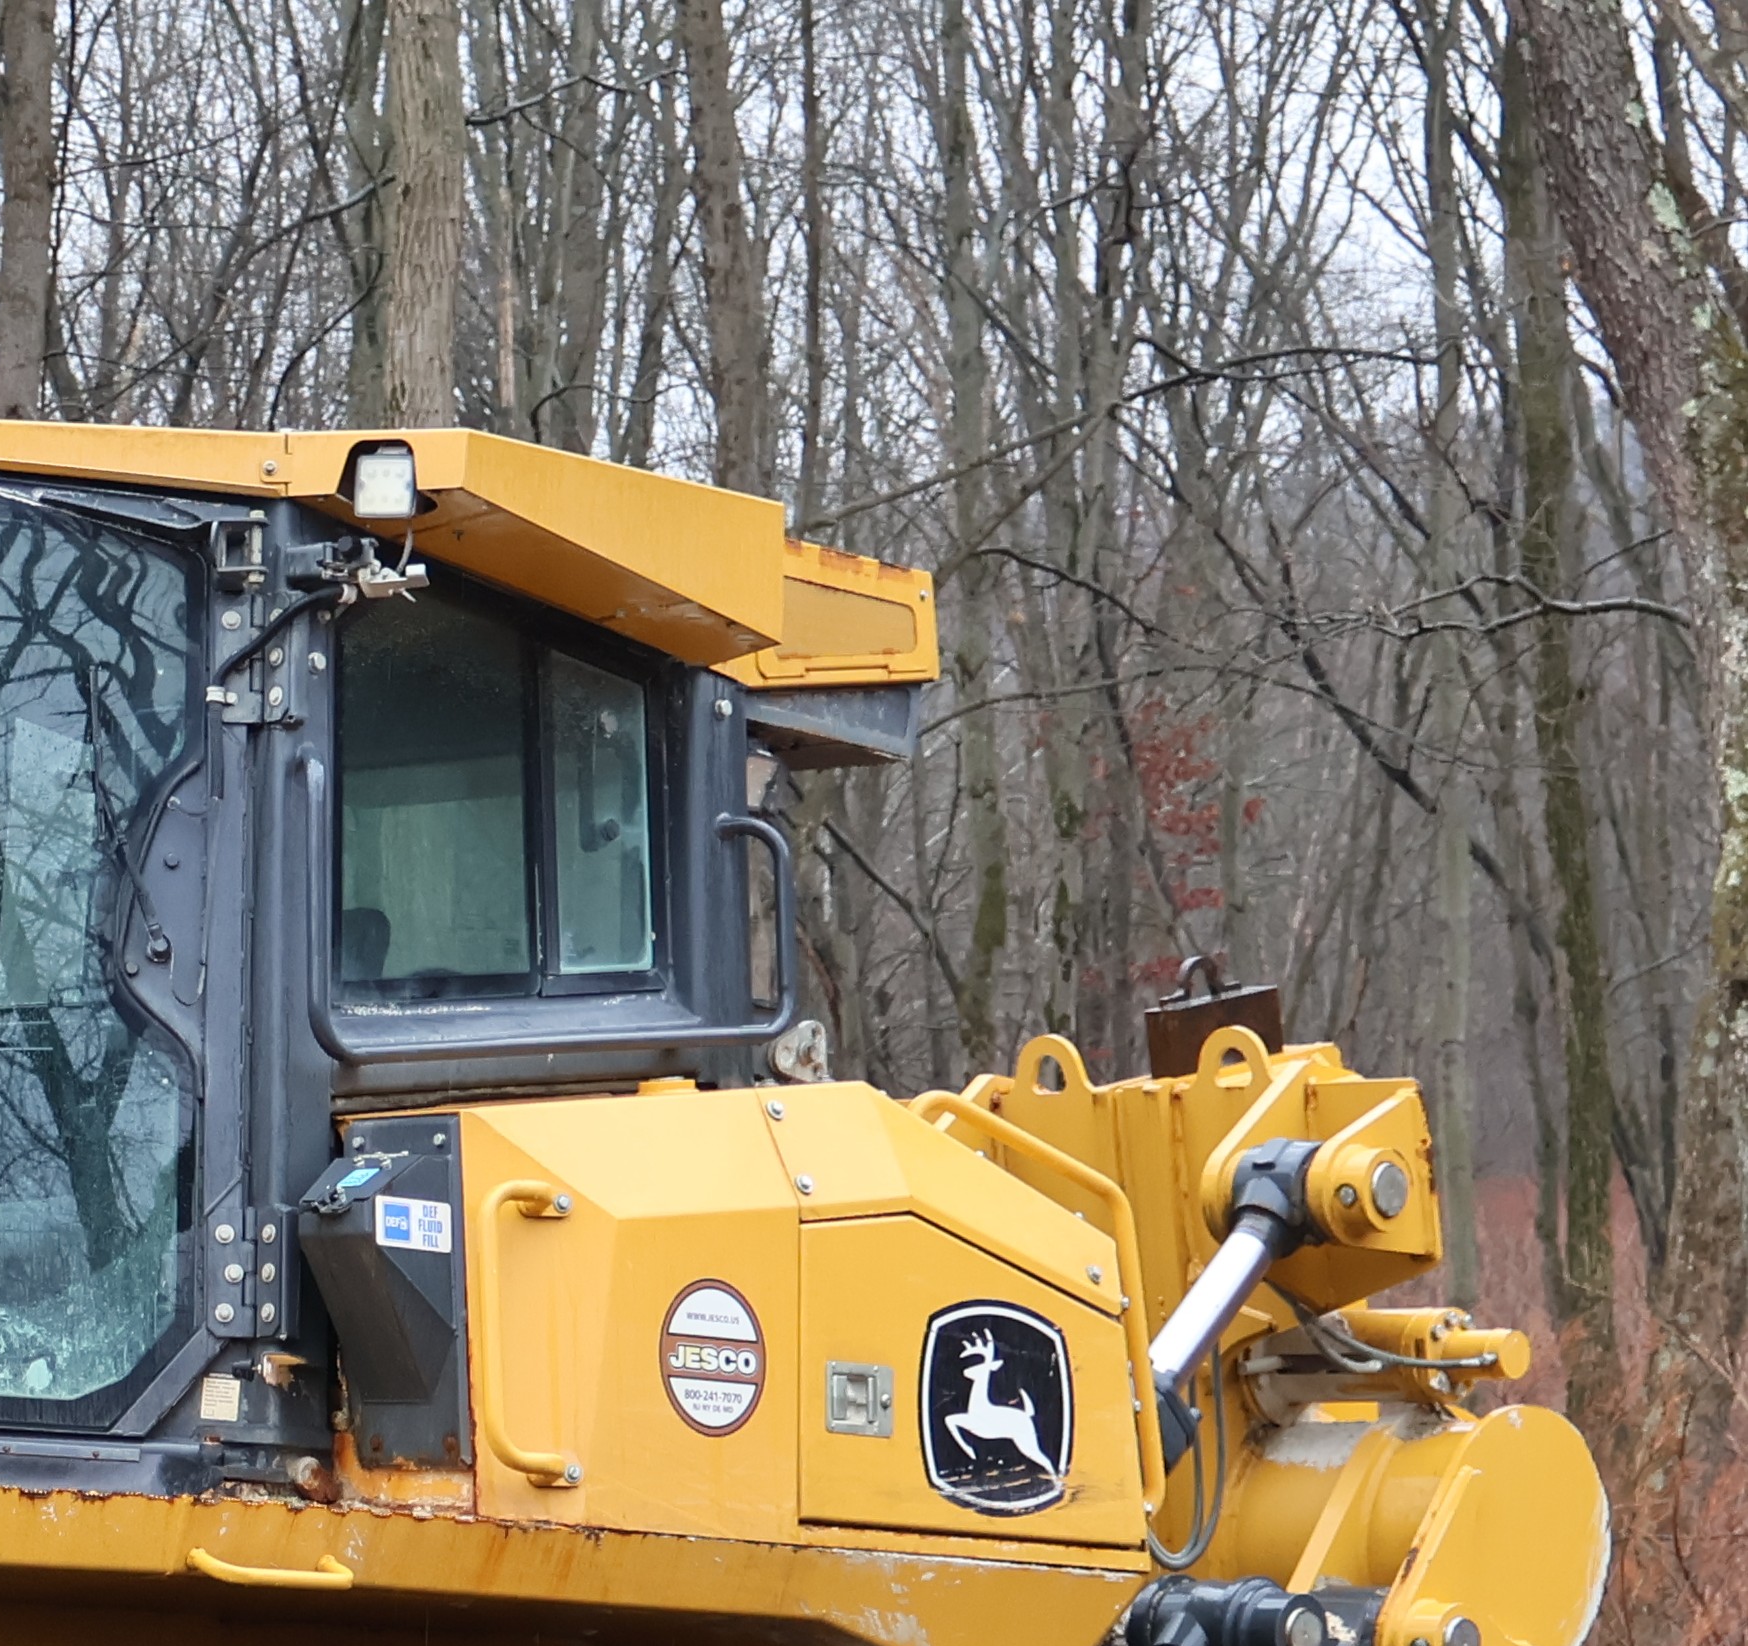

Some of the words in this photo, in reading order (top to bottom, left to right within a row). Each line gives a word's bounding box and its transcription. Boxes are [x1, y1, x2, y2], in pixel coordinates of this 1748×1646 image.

[423, 1204, 438, 1218] DEF
[418, 1218, 443, 1233] FLUID
[422, 1234, 439, 1248] FILL
[668, 1343, 758, 1376] JESCO
[684, 1389, 743, 1404] 800-241-7070
